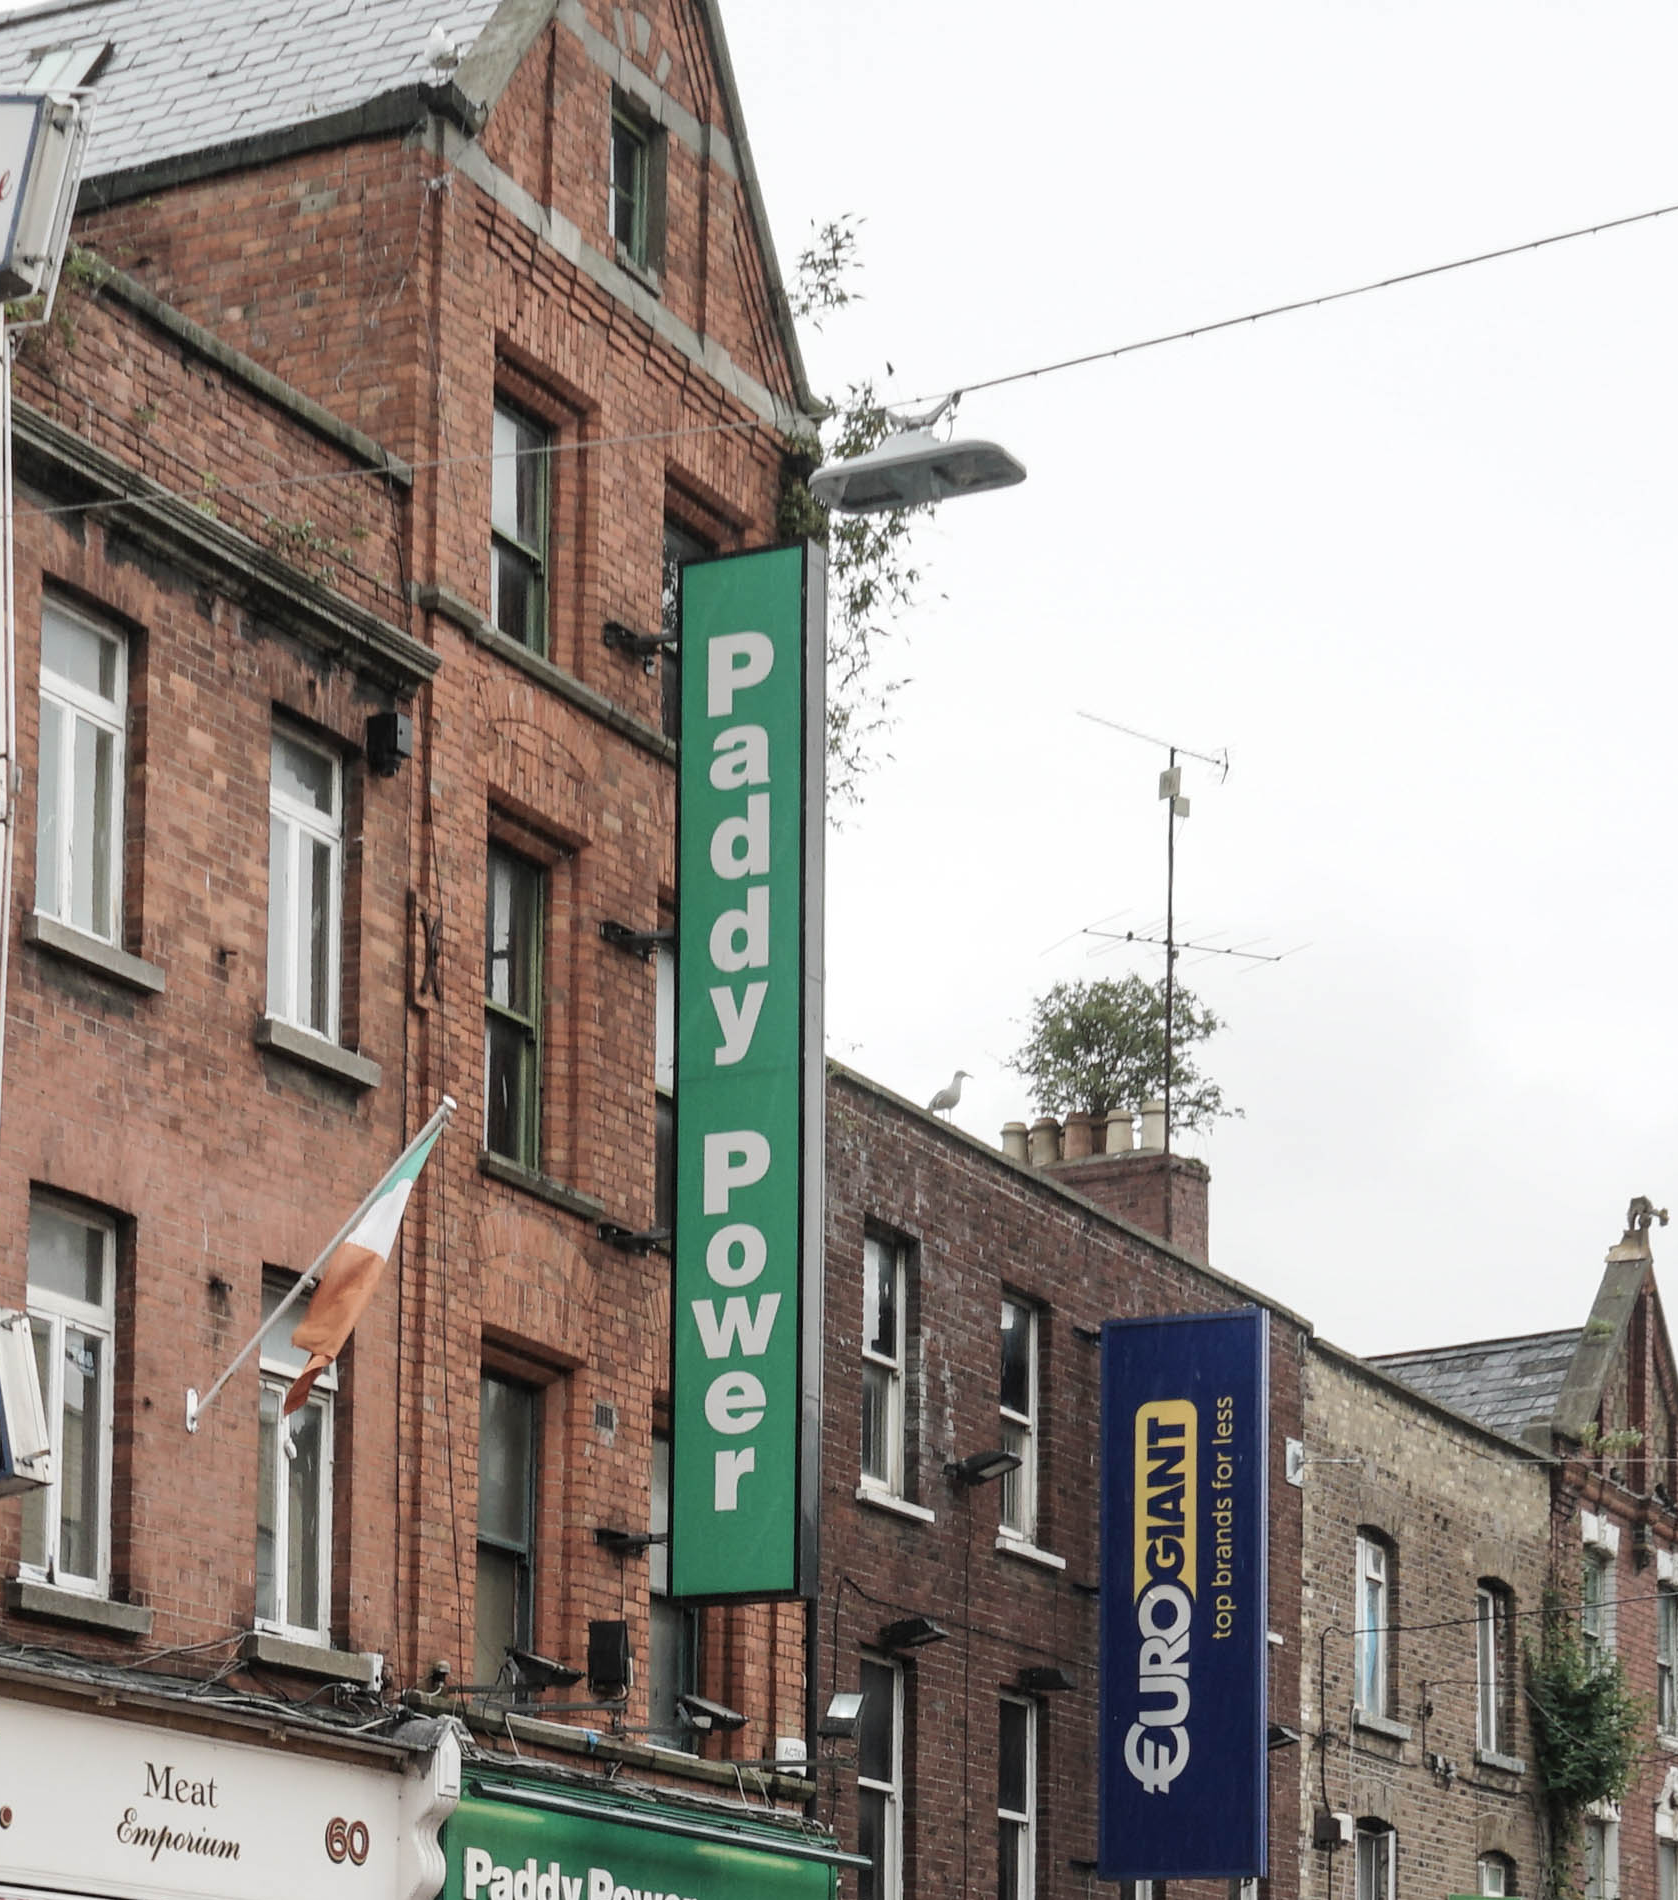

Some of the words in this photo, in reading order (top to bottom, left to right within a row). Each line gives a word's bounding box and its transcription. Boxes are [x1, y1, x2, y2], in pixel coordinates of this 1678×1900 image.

[706, 630, 776, 1067] Paddy
[691, 1130, 782, 1513] Power
[1212, 1396, 1233, 1444] less
[1212, 1453, 1232, 1489] for
[1211, 1497, 1232, 1587] brands
[1212, 1595, 1237, 1640] top
[142, 1760, 219, 1809] Meat
[116, 1806, 241, 1862] Emporium
[324, 1815, 370, 1866] 60
